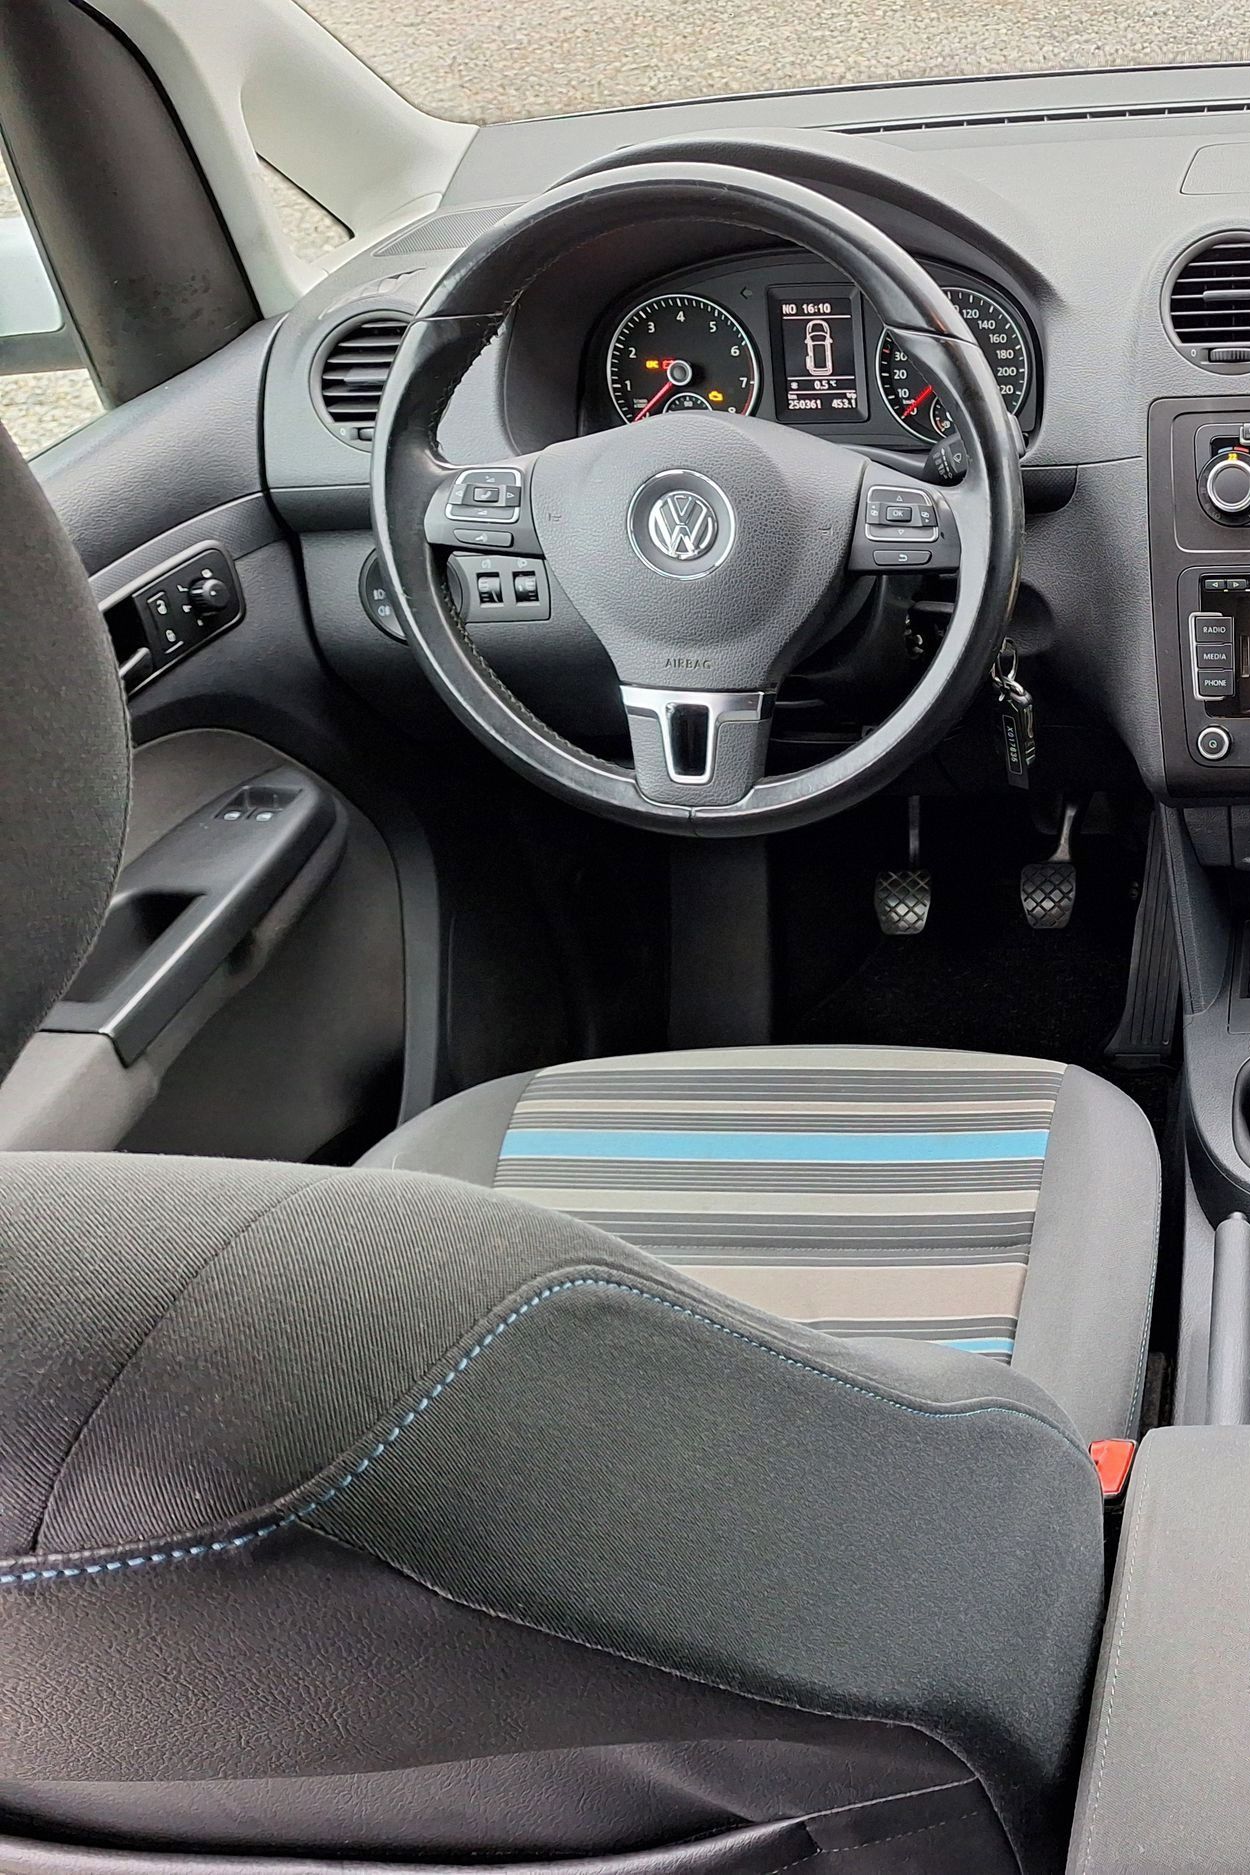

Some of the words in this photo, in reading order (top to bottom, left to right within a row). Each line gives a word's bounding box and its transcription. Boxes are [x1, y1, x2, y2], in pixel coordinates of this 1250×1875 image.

[782, 304, 797, 314] NO
[802, 303, 831, 314] 16:10
[676, 310, 685, 322] 4
[962, 309, 980, 319] 120
[648, 322, 656, 333] 3
[709, 321, 717, 333] 5
[977, 320, 996, 329] 140
[989, 334, 1007, 343] 160
[628, 347, 637, 359] 2
[730, 346, 740, 357] 6
[894, 352, 908, 361] 30
[996, 350, 1014, 359] 180
[893, 370, 907, 380] 20
[997, 367, 1017, 377] 200
[625, 380, 632, 391] 1
[739, 377, 748, 388] 7
[814, 380, 829, 390] 0.5
[898, 389, 909, 398] 10
[998, 385, 1014, 395] 20
[788, 400, 822, 410] 250361
[831, 399, 856, 409] 453.1
[892, 509, 904, 517] OK
[1202, 626, 1227, 634] RADIO
[664, 658, 712, 669] AIRBAG
